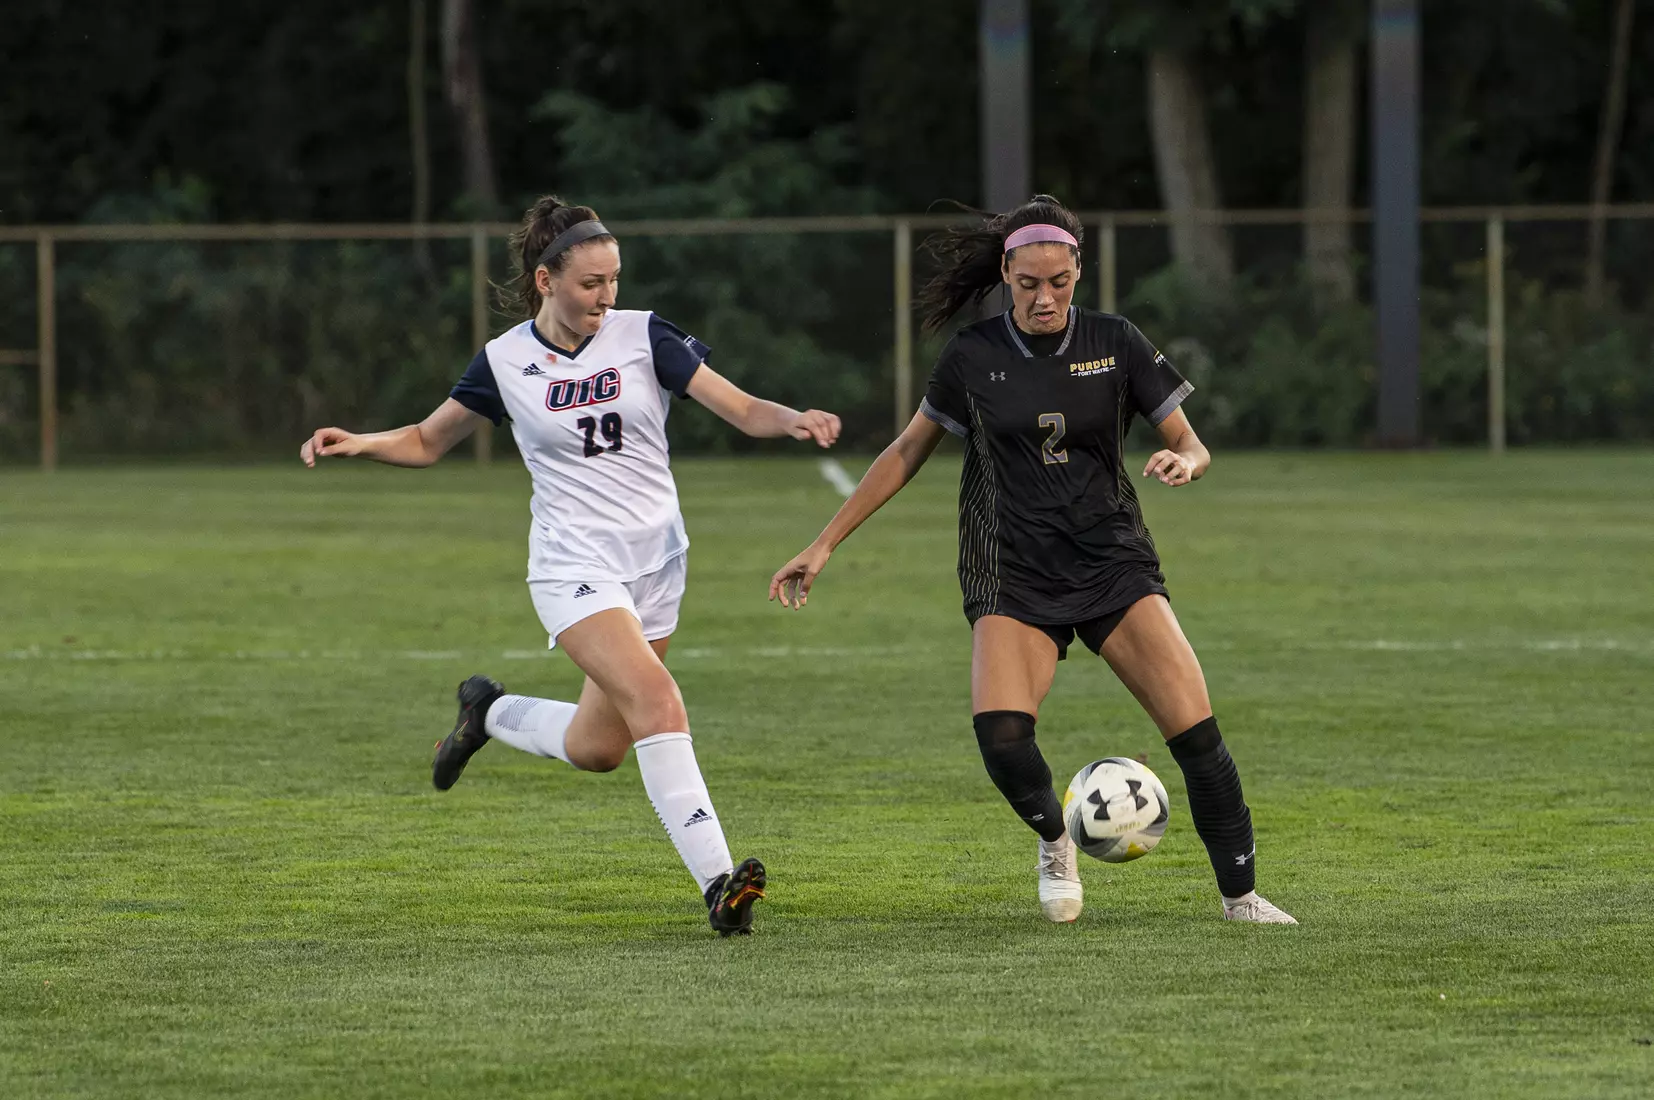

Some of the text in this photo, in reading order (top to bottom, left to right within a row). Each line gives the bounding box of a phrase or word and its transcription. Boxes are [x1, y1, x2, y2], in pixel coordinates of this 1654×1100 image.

[1070, 356, 1115, 372] PURDUE
[546, 367, 620, 412] UIC
[577, 412, 623, 458] 29
[1038, 412, 1068, 464] 2
[684, 815, 713, 827] adidas
